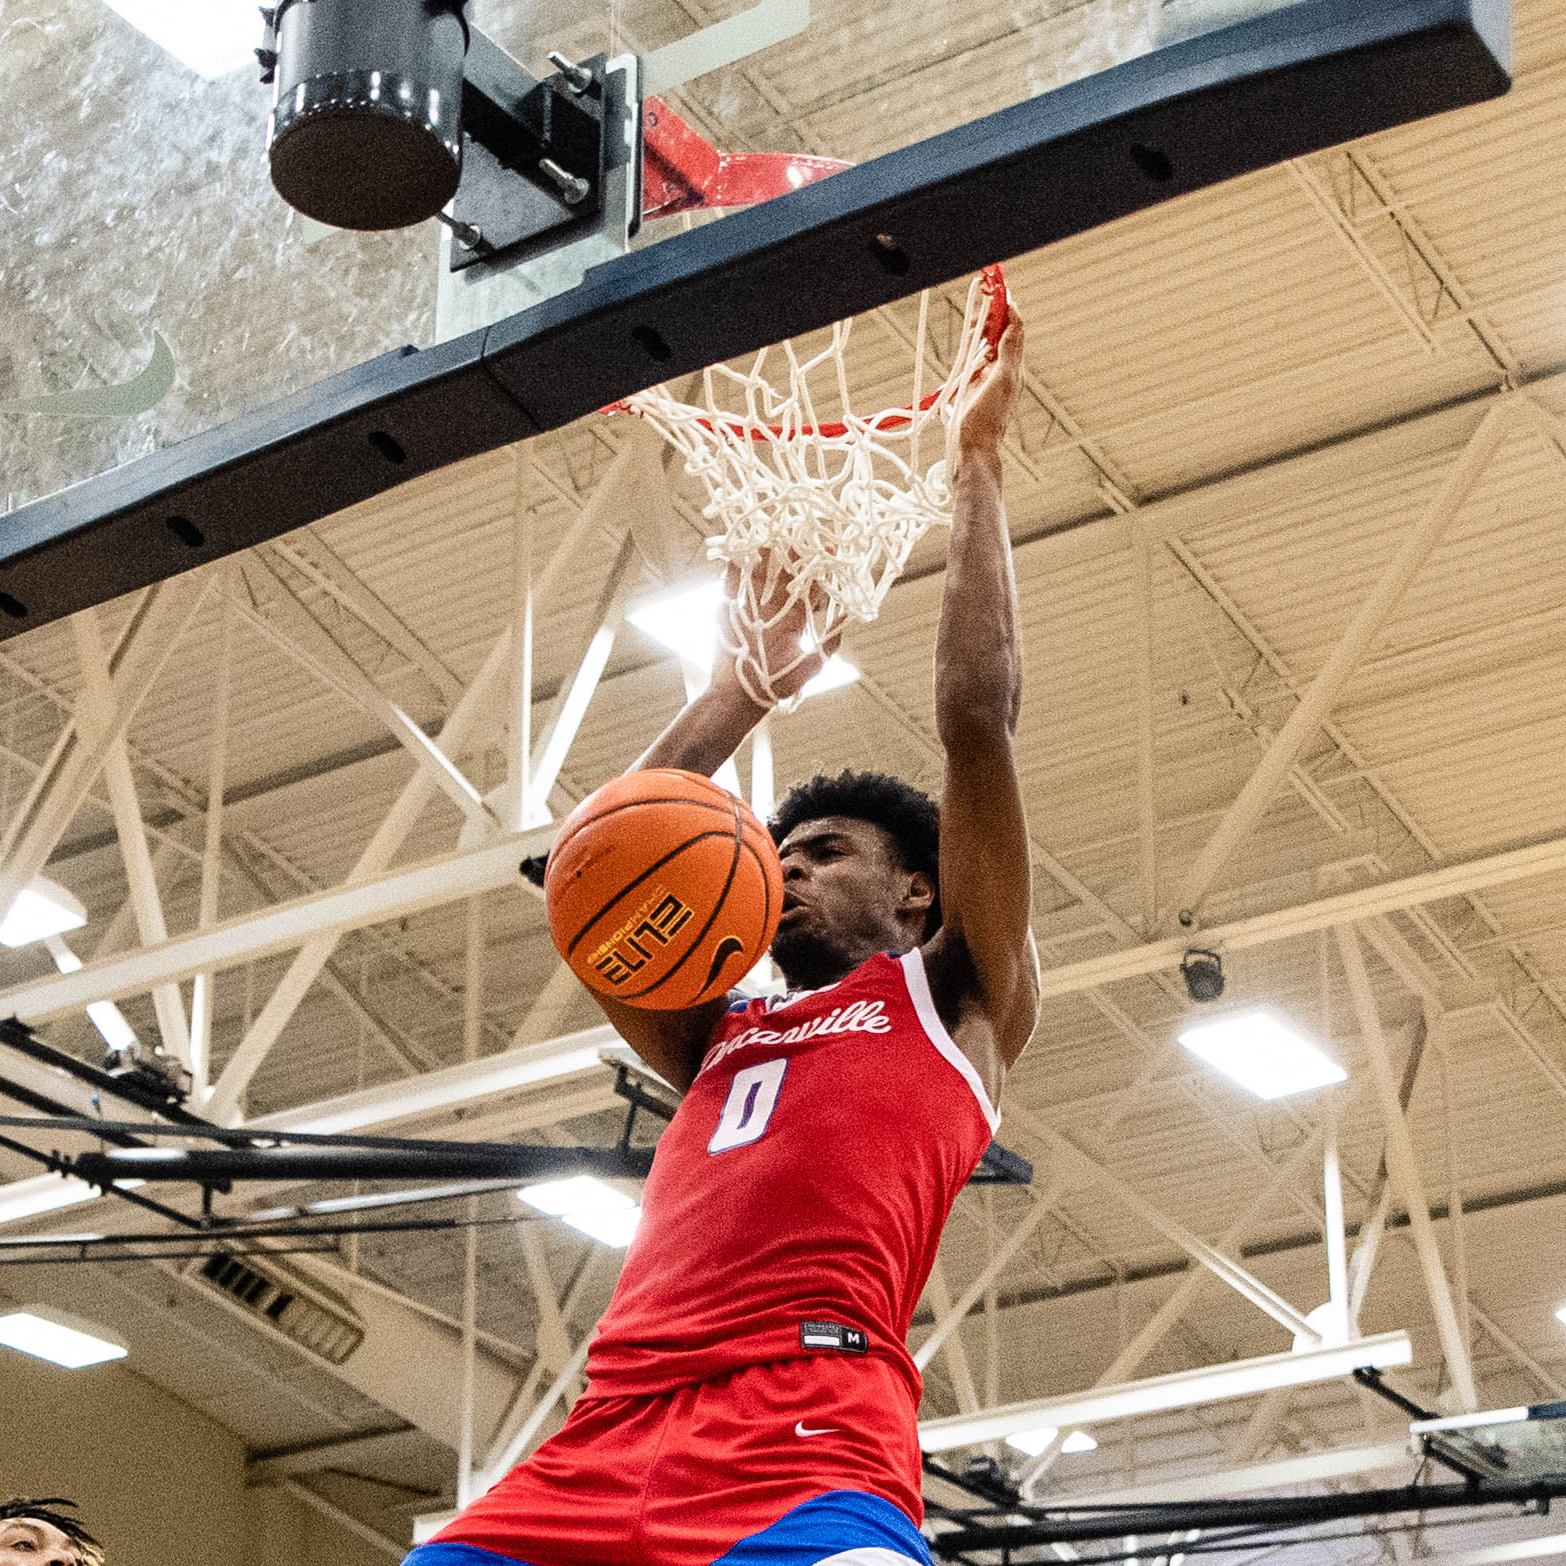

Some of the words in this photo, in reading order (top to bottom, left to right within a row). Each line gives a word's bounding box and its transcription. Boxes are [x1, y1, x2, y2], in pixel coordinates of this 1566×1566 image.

[594, 892, 695, 986] ELITE
[708, 1057, 789, 1156] 0
[847, 1332, 860, 1344] M
